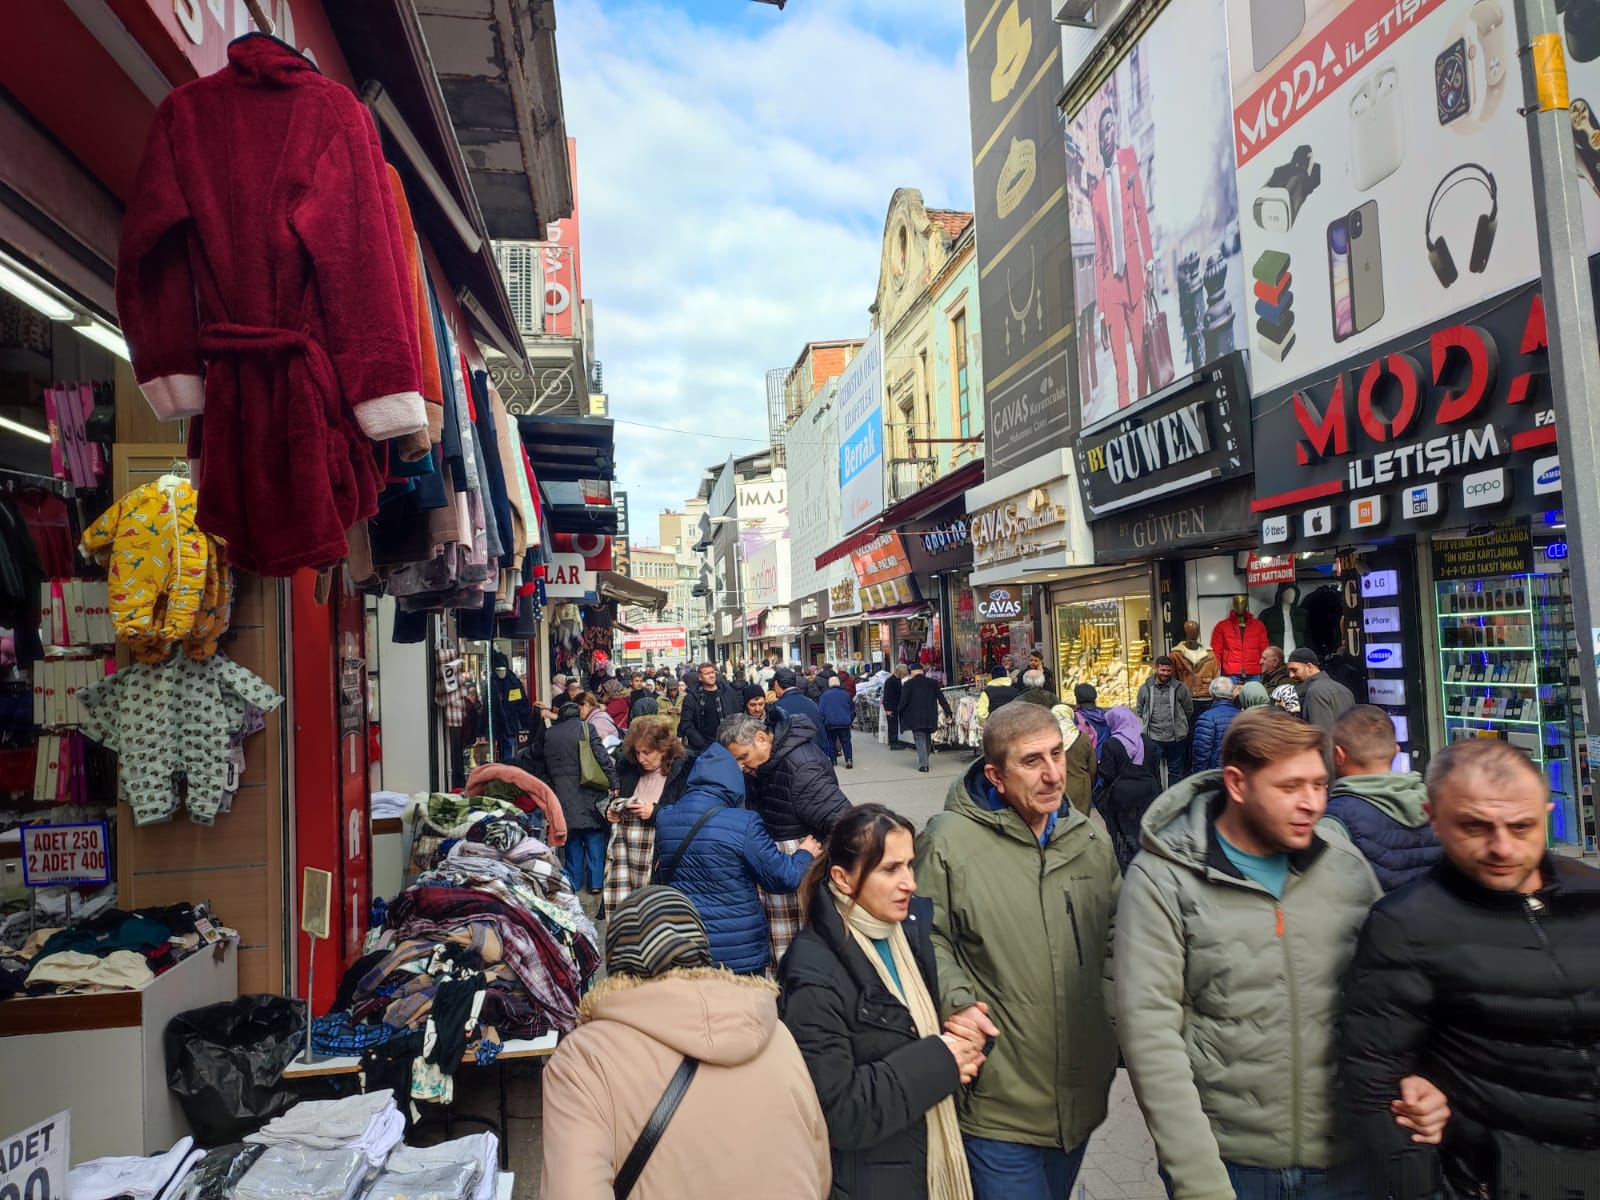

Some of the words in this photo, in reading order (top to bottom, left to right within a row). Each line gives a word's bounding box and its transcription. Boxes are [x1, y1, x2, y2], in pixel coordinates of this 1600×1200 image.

[1239, 41, 1343, 155] MODA
[1345, 0, 1429, 68] İLETİŞ
[1293, 294, 1548, 465] MODA
[844, 422, 875, 480] Berrak
[1087, 444, 1106, 473] BY
[1105, 400, 1207, 485] GÜWEN
[1348, 423, 1500, 491] İLETİŞİM
[739, 487, 784, 508] İMAJ
[1466, 479, 1501, 496] oppo
[1132, 504, 1206, 549] GÜWEN
[1271, 524, 1286, 536] ttec
[1547, 543, 1568, 558] CEP
[978, 600, 1022, 614] ÇAVAŞ
[34, 831, 68, 852] ADET
[73, 830, 98, 850] 250
[28, 854, 38, 873] 2
[42, 852, 77, 872] ADET
[81, 851, 106, 870] 400
